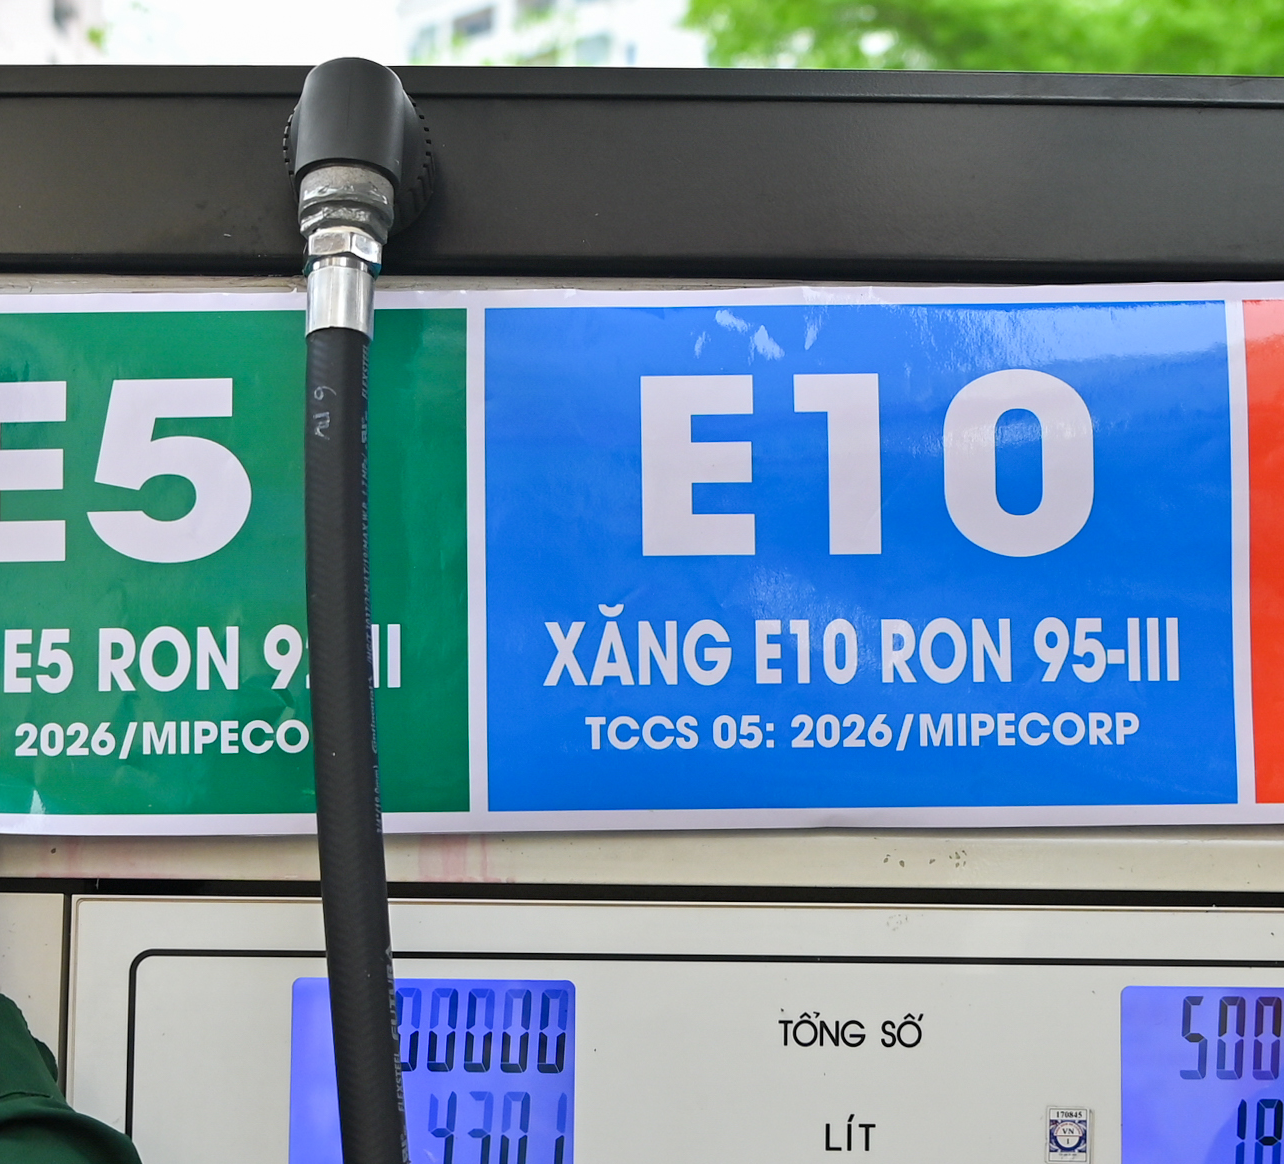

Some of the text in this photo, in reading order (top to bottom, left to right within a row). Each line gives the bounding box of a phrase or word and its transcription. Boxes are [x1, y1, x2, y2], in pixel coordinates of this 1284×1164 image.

[640, 369, 1094, 557] E10
[4, 628, 73, 694] E5
[98, 626, 239, 693] RON
[543, 604, 1179, 686] XĂNG E10 RON 95-III
[15, 719, 310, 760] 2026/MIPECO
[585, 711, 1140, 752] TCCS 05: 2026/MIPECORP
[778, 1012, 924, 1048] TỔNG SỐ
[825, 1114, 876, 1151] LÍT
